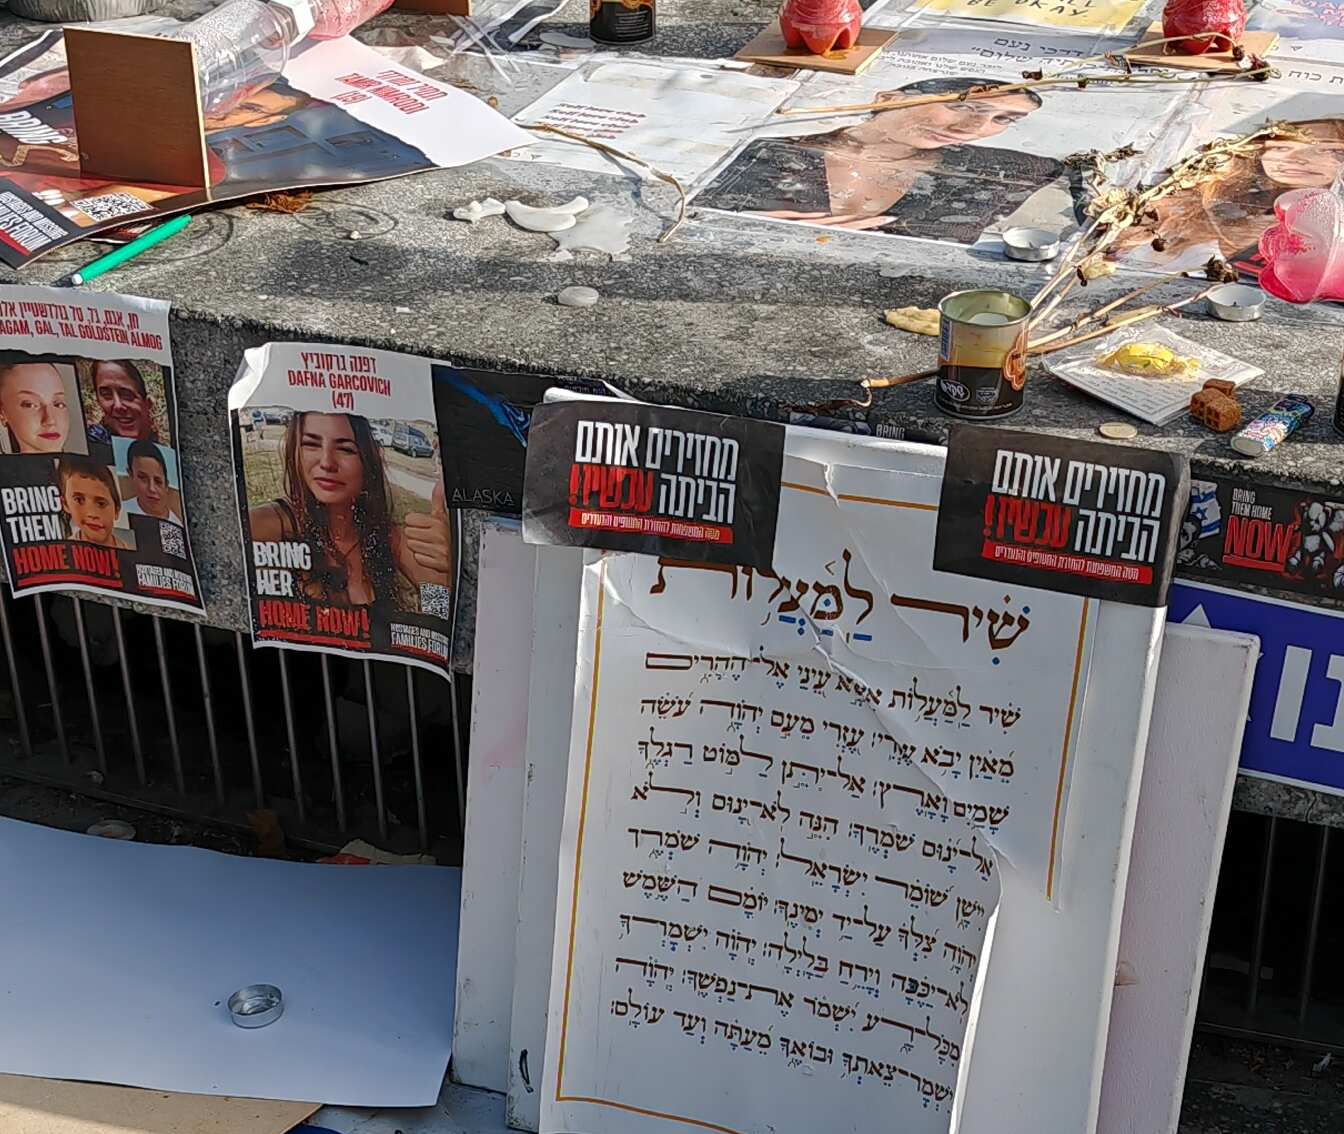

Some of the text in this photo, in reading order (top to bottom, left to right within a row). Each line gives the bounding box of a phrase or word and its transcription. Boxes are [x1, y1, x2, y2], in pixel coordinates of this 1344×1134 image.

[1288, 70, 1322, 81] כוח
[35, 320, 59, 338] GAL,
[58, 321, 79, 338] TAL
[78, 323, 130, 345] GOLDSTEIN
[131, 332, 163, 351] ALMOG
[300, 352, 377, 374] דפנה גרקוביץ
[287, 369, 392, 397] DAFNA GARCOVICH
[331, 391, 355, 411] (47)
[876, 423, 905, 440] BRING
[575, 419, 740, 481] מחזירים אותם
[451, 487, 515, 506] ALASKA
[568, 463, 737, 525] הביתה עכשיו!
[991, 448, 1167, 518] מחזירים אותם
[1232, 487, 1256, 503] BRING
[1, 485, 63, 515] BRING
[1232, 501, 1273, 521] THEM HOME
[6, 513, 64, 544] THEM
[983, 495, 1161, 563] הביתה עכשיו!
[1224, 515, 1294, 558] NOW
[12, 543, 70, 575] HOME
[72, 543, 121, 578] NOW!
[253, 541, 312, 570] BRING
[256, 567, 295, 597] HER
[258, 600, 370, 638] HOME NOW!
